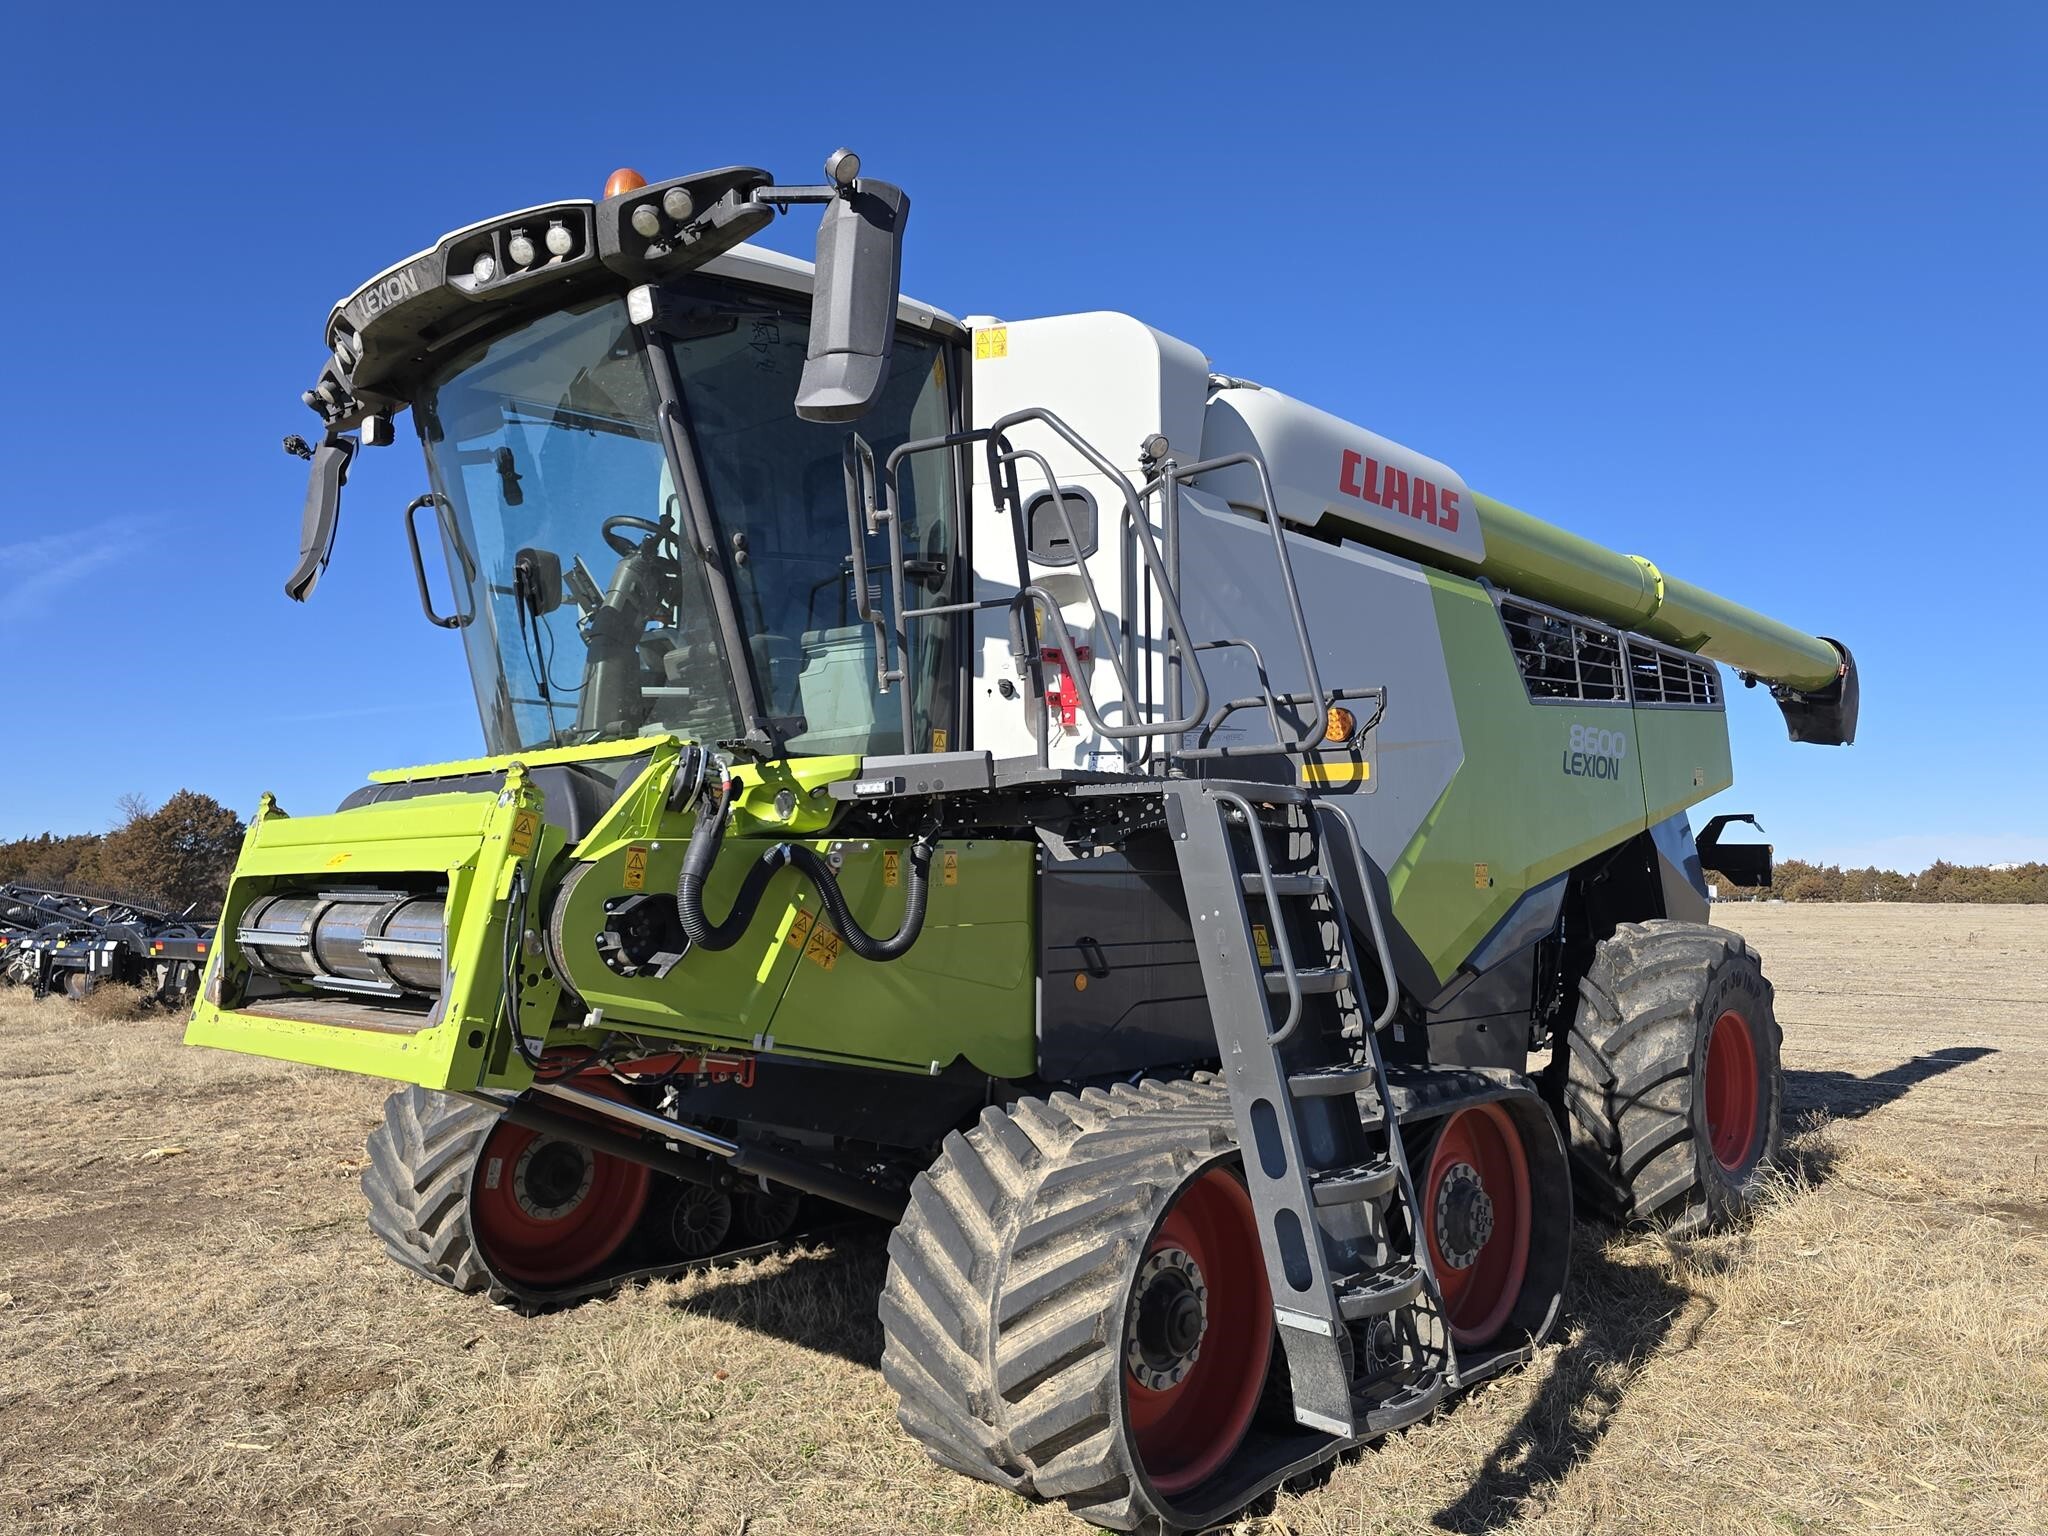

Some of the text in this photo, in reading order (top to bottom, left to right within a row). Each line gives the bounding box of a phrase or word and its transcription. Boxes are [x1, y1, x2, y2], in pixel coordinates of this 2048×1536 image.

[358, 268, 419, 319] LEXION
[1339, 448, 1460, 533] CLAAS
[1569, 723, 1627, 759] 8600
[1562, 750, 1619, 781] LEXION
